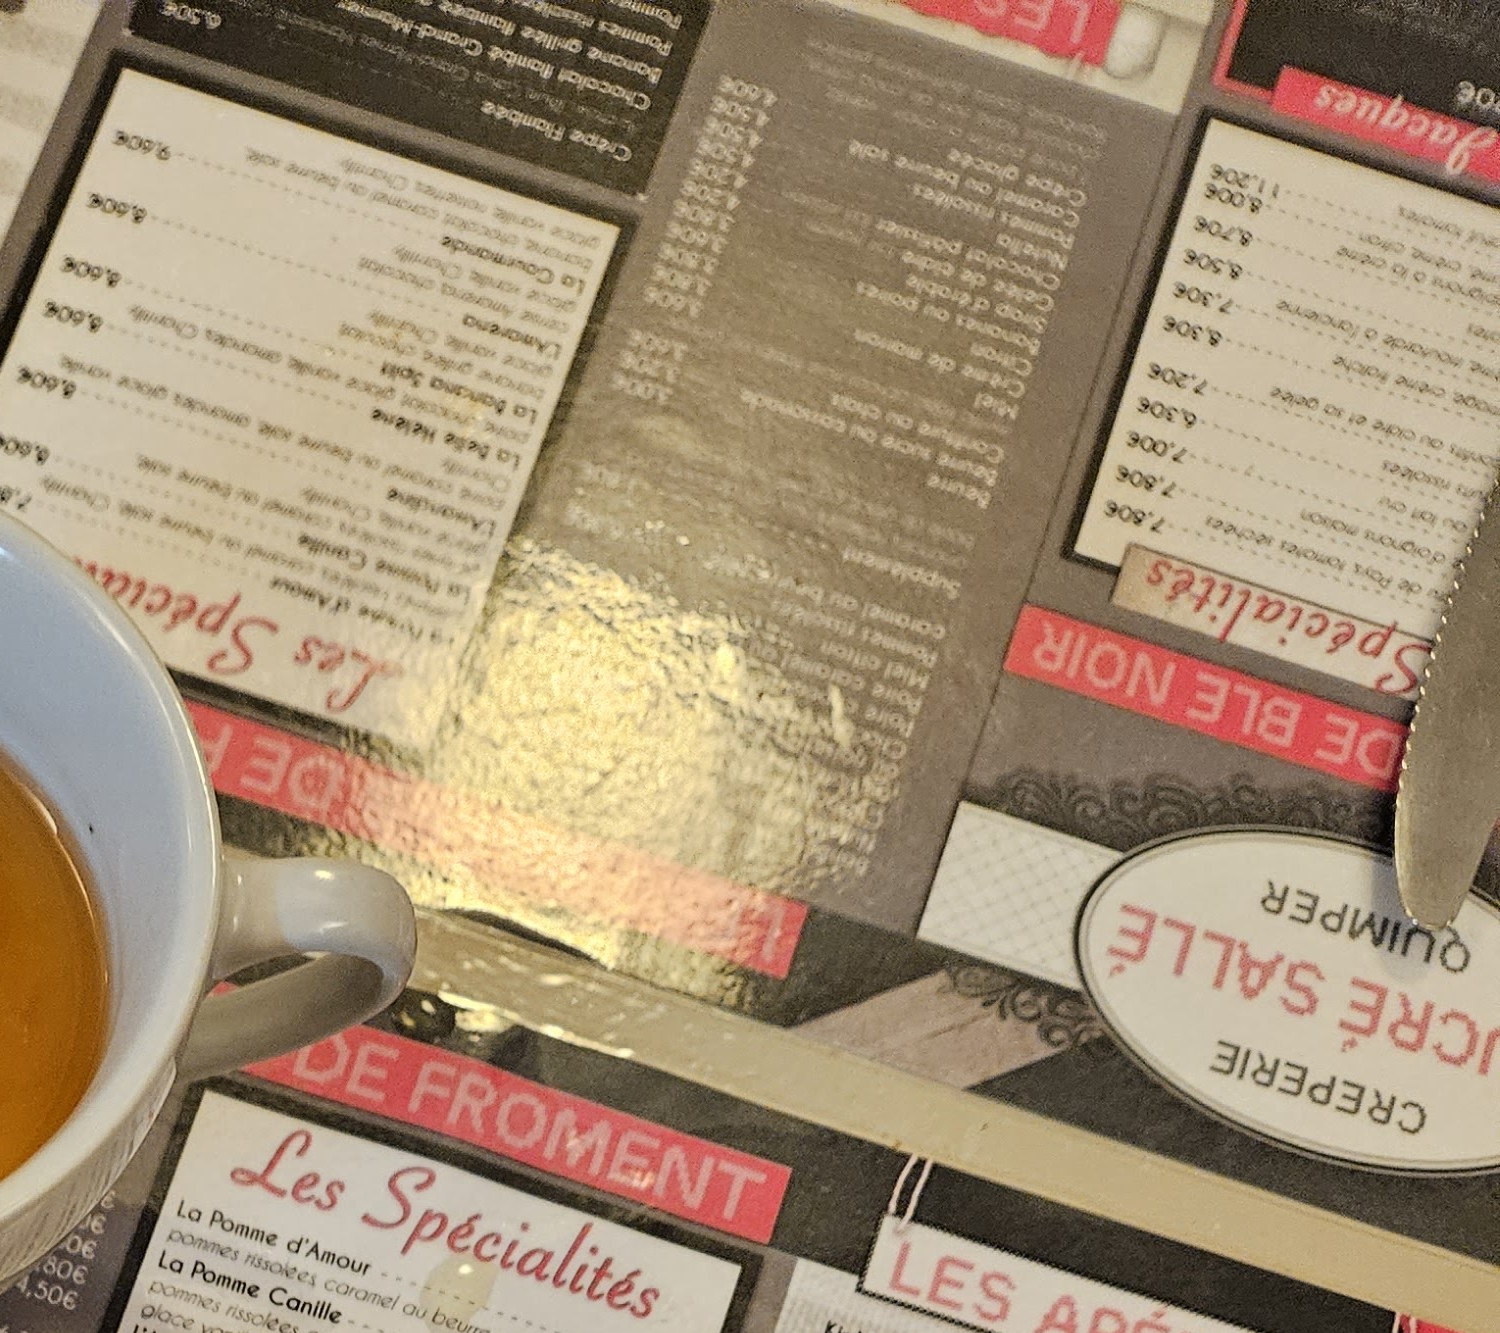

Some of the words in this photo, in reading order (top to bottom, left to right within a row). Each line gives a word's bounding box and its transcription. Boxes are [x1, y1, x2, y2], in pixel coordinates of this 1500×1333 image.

[1320, 72, 1500, 171] Jacques
[1034, 625, 1176, 702] NOIR
[1134, 562, 1431, 701] Spécialités
[1187, 673, 1302, 744] BLE
[1110, 906, 1320, 1014] SALLÉ
[1263, 886, 1468, 971] QUIMPER
[1339, 977, 1500, 1076] CRÉ
[295, 1023, 394, 1098] DE
[407, 1060, 771, 1224] FROMENT
[1213, 1041, 1425, 1133] CREPERIE
[176, 1199, 202, 1222] La
[209, 1209, 277, 1245] Pomme
[286, 1238, 369, 1274] d'Amour
[231, 1130, 347, 1209] Les
[362, 1167, 662, 1318] Spécialités
[157, 1250, 185, 1274] La
[191, 1260, 259, 1297] Pomme
[268, 1287, 341, 1323] Canille
[888, 1243, 1011, 1321] LES
